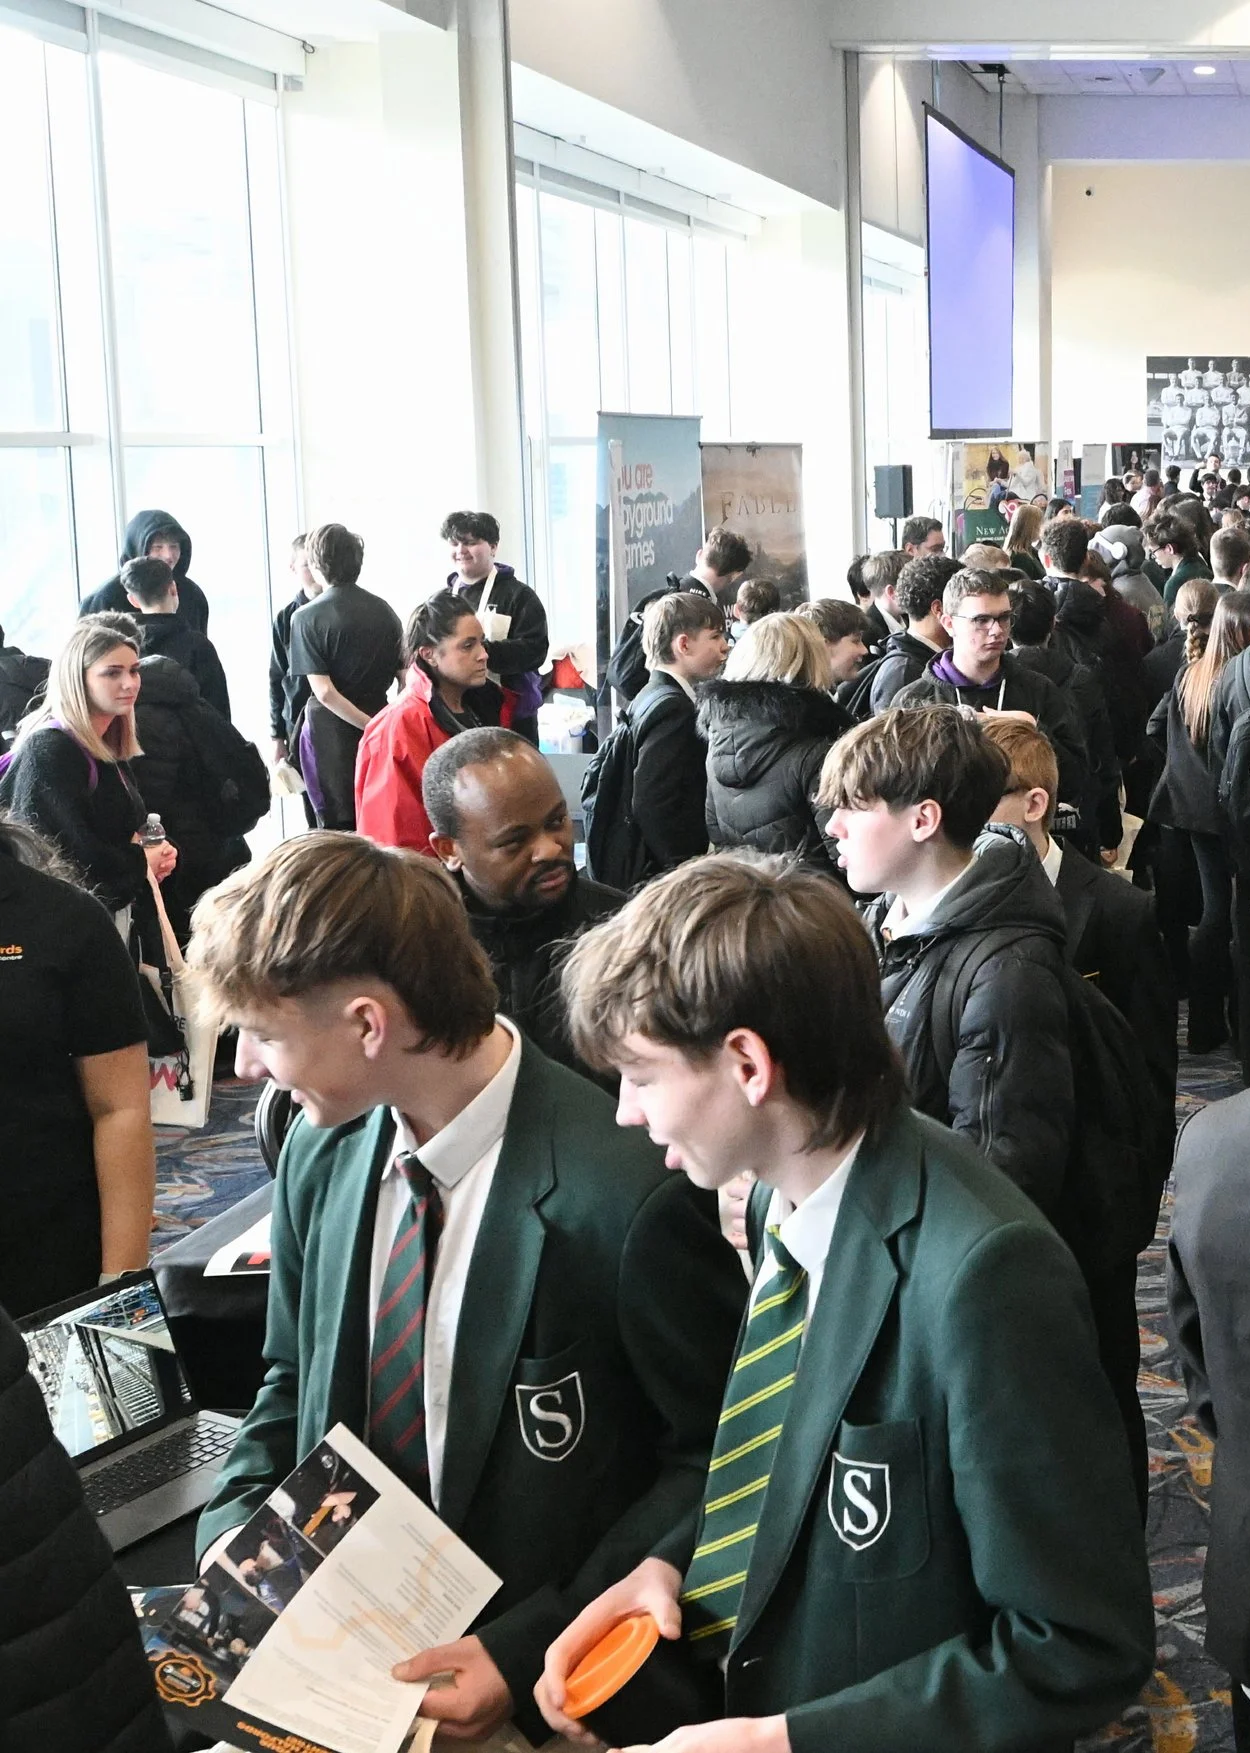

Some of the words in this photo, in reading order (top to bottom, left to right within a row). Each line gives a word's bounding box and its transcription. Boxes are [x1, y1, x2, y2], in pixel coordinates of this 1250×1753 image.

[635, 464, 653, 489] are
[720, 491, 798, 525] FABLE
[0, 944, 23, 955] rds
[529, 1390, 572, 1448] S
[843, 1469, 879, 1536] S
